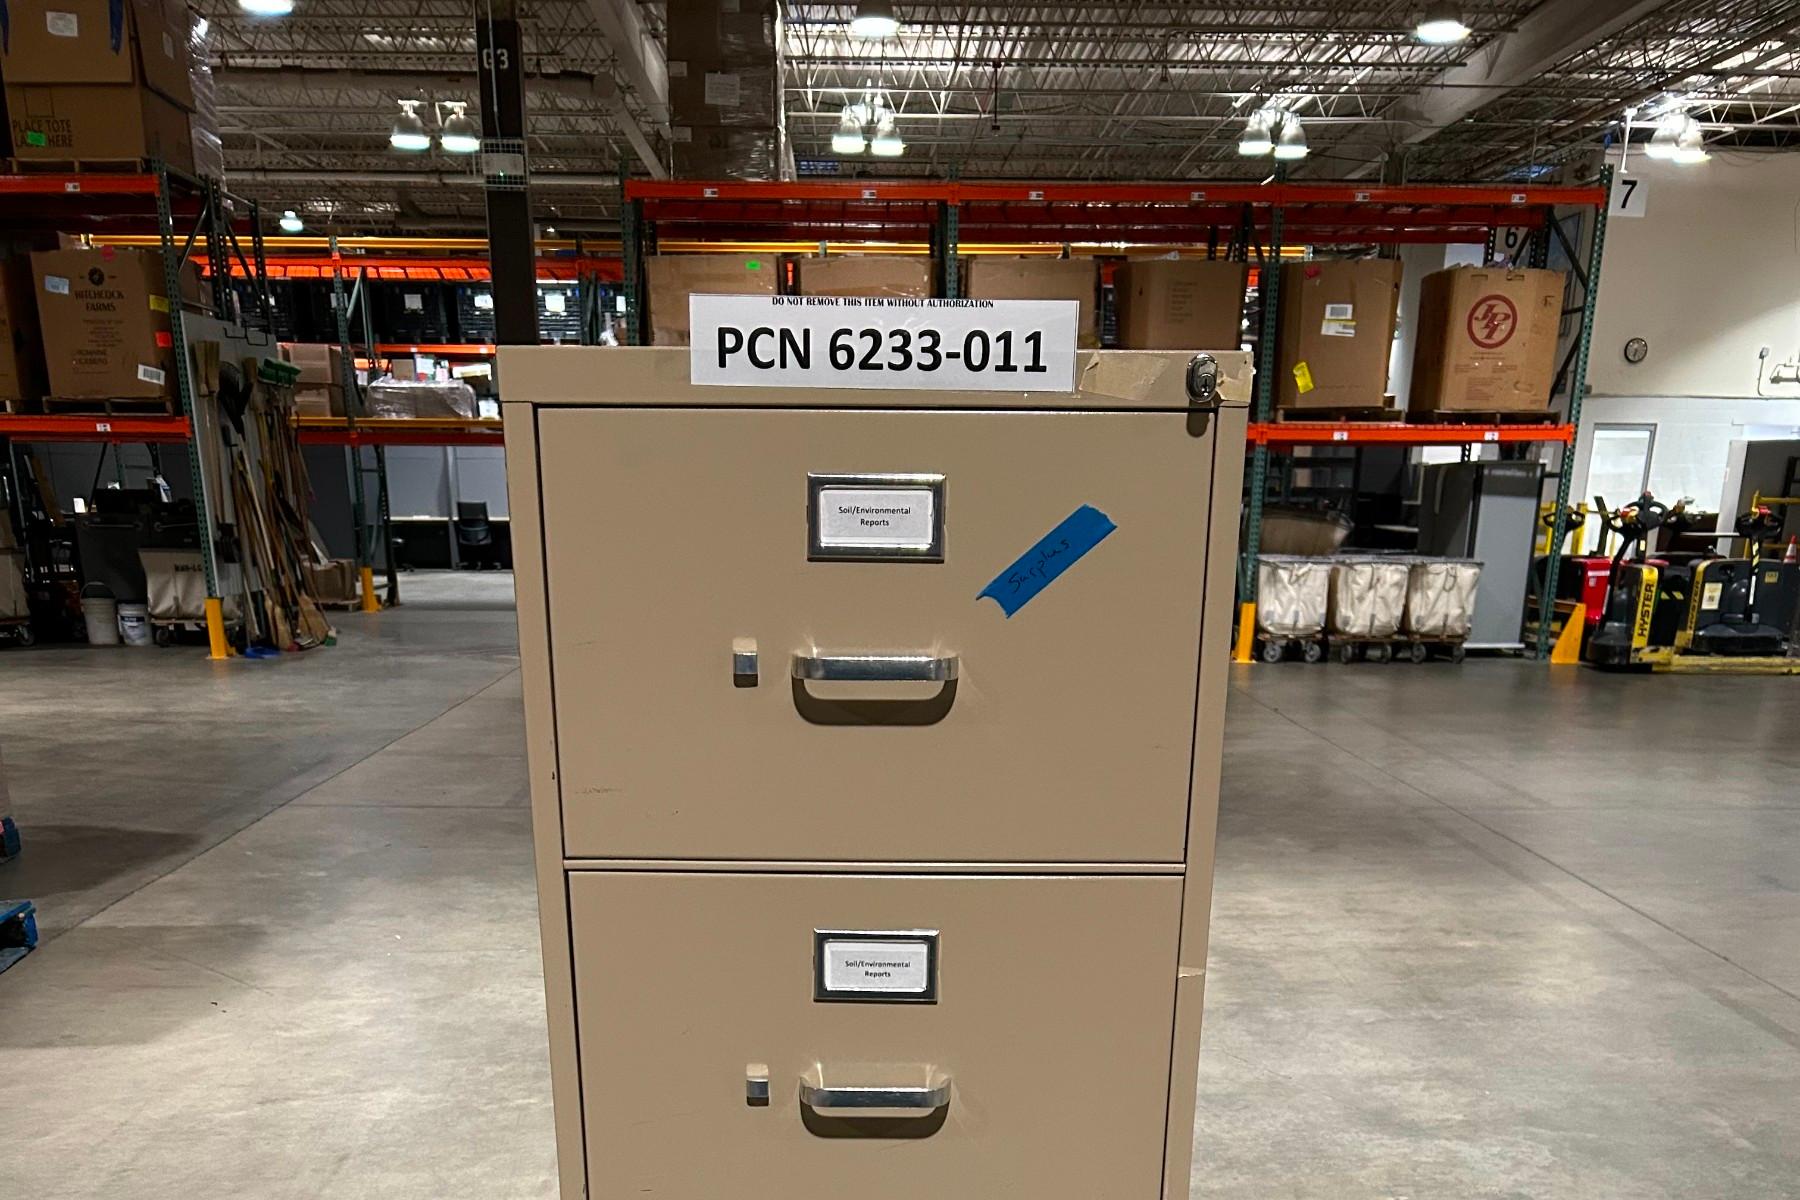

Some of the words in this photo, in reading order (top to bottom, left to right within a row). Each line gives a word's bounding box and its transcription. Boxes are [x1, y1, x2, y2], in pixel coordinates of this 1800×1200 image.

[46, 119, 72, 133] TOTE
[47, 134, 73, 148] HERE
[1621, 179, 1638, 209] 7
[1504, 226, 1518, 249] 6
[86, 302, 116, 312] FARMS
[772, 296, 785, 306] DO
[787, 296, 804, 306] NOT
[806, 296, 840, 306] REMOVE
[843, 297, 862, 307] THIS
[864, 297, 884, 307] ITEM
[887, 298, 924, 308] WITHOUT
[927, 298, 994, 308] AUTHORIZATION
[717, 326, 811, 370] PCN
[829, 328, 1047, 373] 6233-011
[838, 506, 911, 515] Soil/Environmental
[860, 518, 890, 527] Reports
[1008, 539, 1070, 593] Surplus
[1637, 582, 1655, 638] HYSTER
[844, 960, 911, 968] Soil/Environmental
[864, 970, 891, 978] Reports
